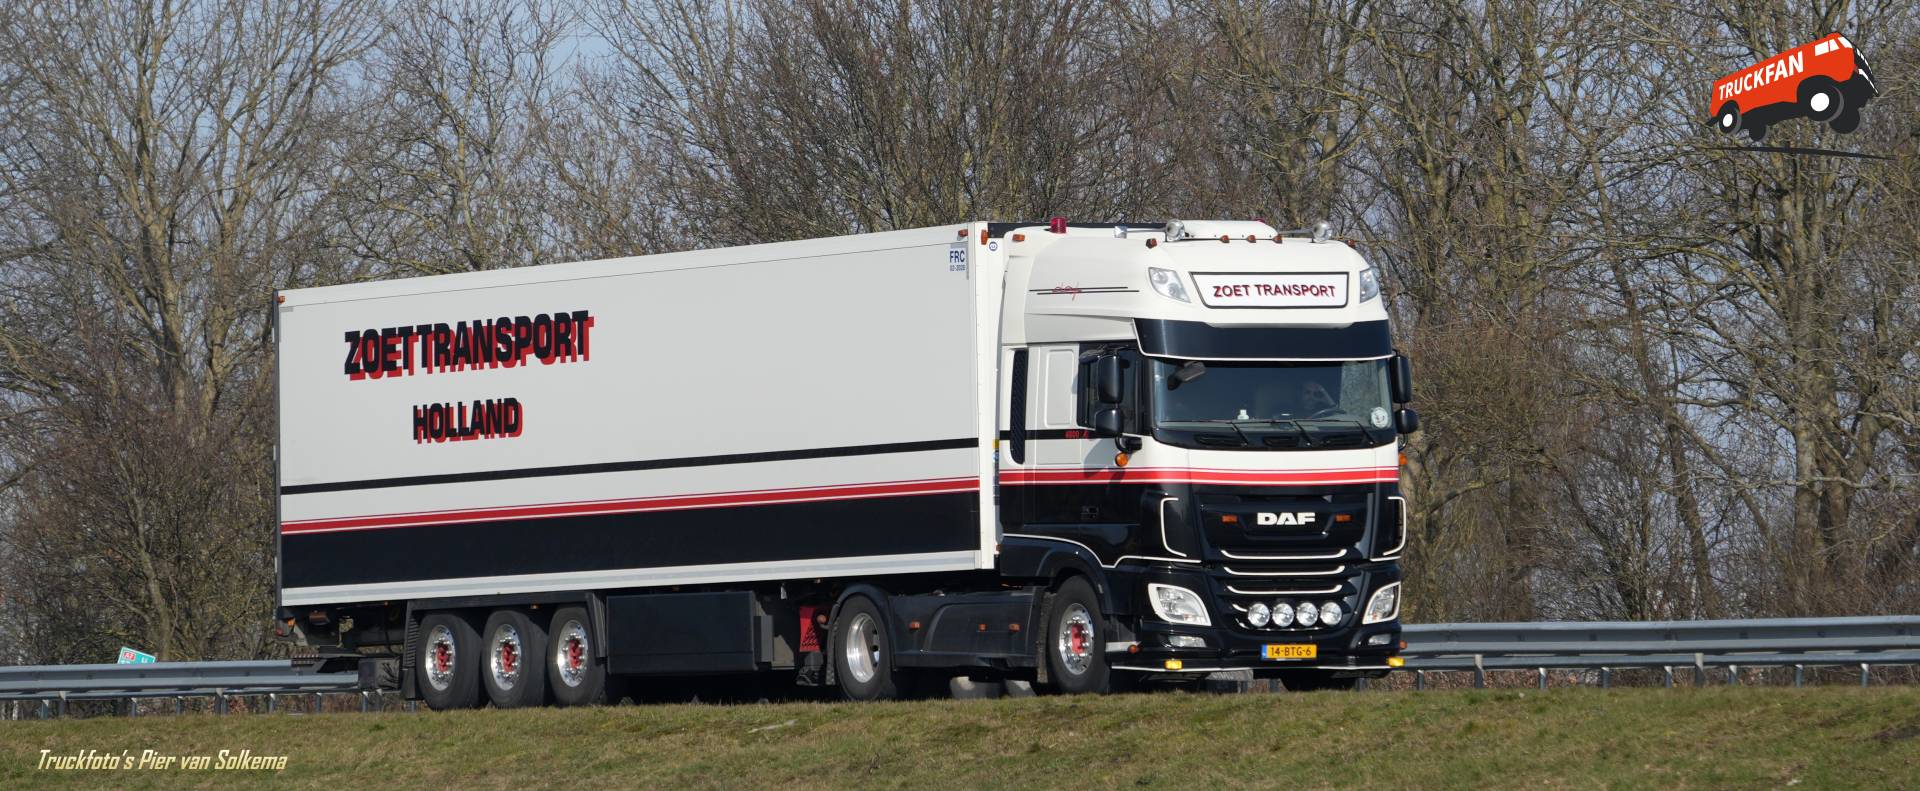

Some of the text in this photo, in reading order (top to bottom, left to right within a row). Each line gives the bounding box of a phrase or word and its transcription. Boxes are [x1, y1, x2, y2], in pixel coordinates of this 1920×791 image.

[950, 250, 965, 263] FRC
[1213, 284, 1336, 298] ZOET TRANSPORT
[413, 397, 523, 444] HOLLAND
[1257, 512, 1316, 525] DAF
[1271, 646, 1312, 657] 14-BTG-6
